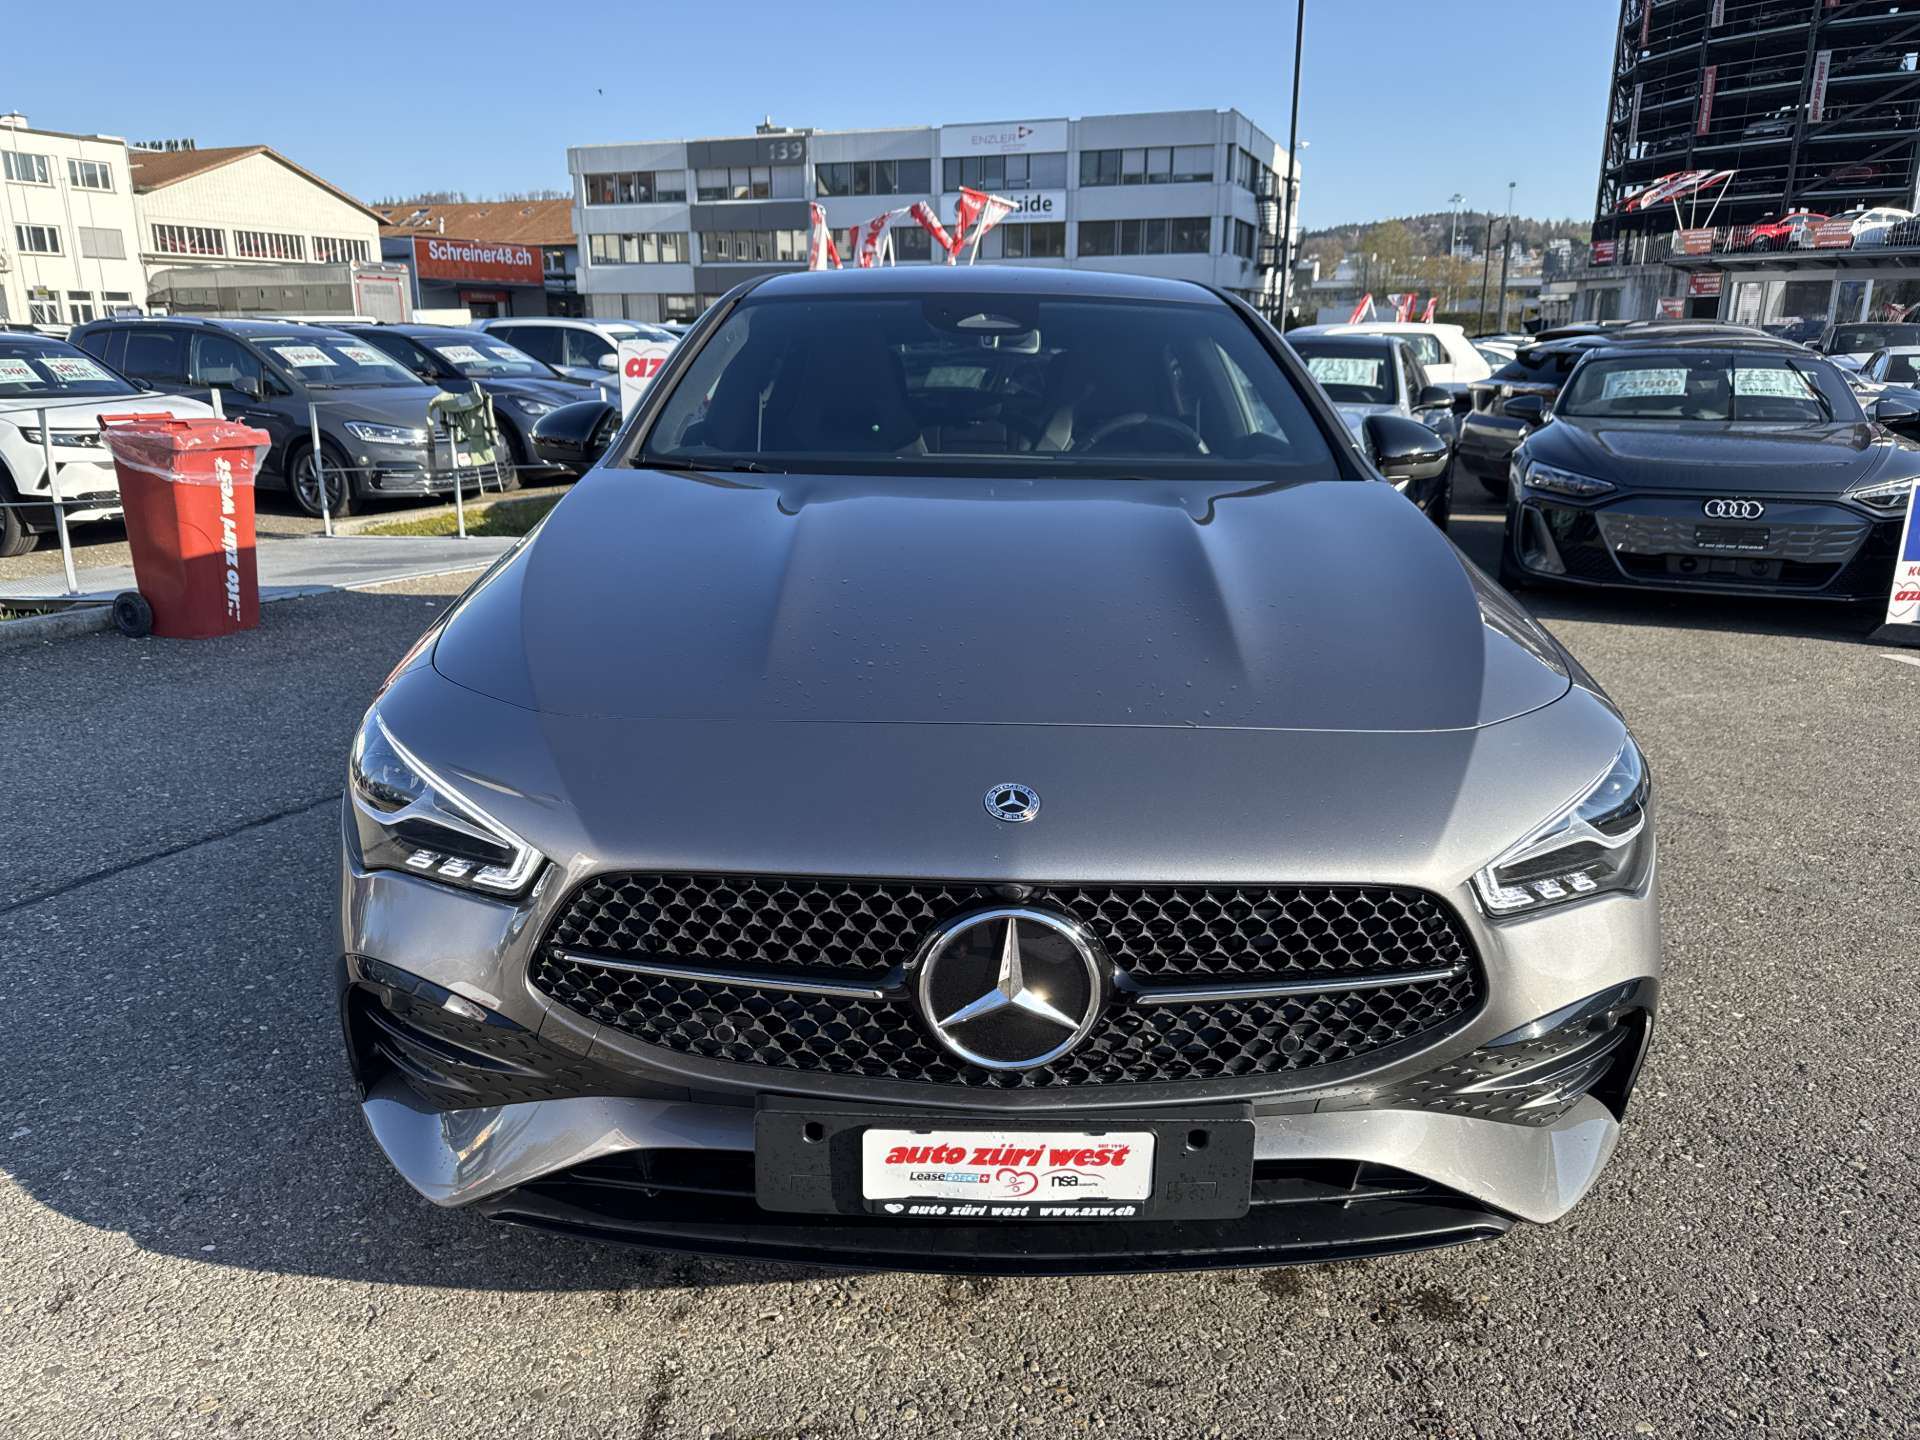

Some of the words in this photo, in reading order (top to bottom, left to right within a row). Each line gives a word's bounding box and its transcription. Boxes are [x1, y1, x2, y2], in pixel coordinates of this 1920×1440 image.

[971, 133, 1016, 145] ENZLER
[769, 142, 802, 160] 139
[428, 240, 532, 265] Schreiner48.ch
[214, 456, 236, 515] west
[220, 516, 239, 569] züri
[885, 1143, 966, 1164] auto
[967, 1144, 1046, 1167] züri
[1049, 1145, 1130, 1167] west
[1051, 1175, 1078, 1187] nsa
[908, 1204, 947, 1215] auto
[949, 1204, 987, 1216] züri
[991, 1205, 1029, 1217] west
[1040, 1205, 1136, 1217] www.azw.ch
